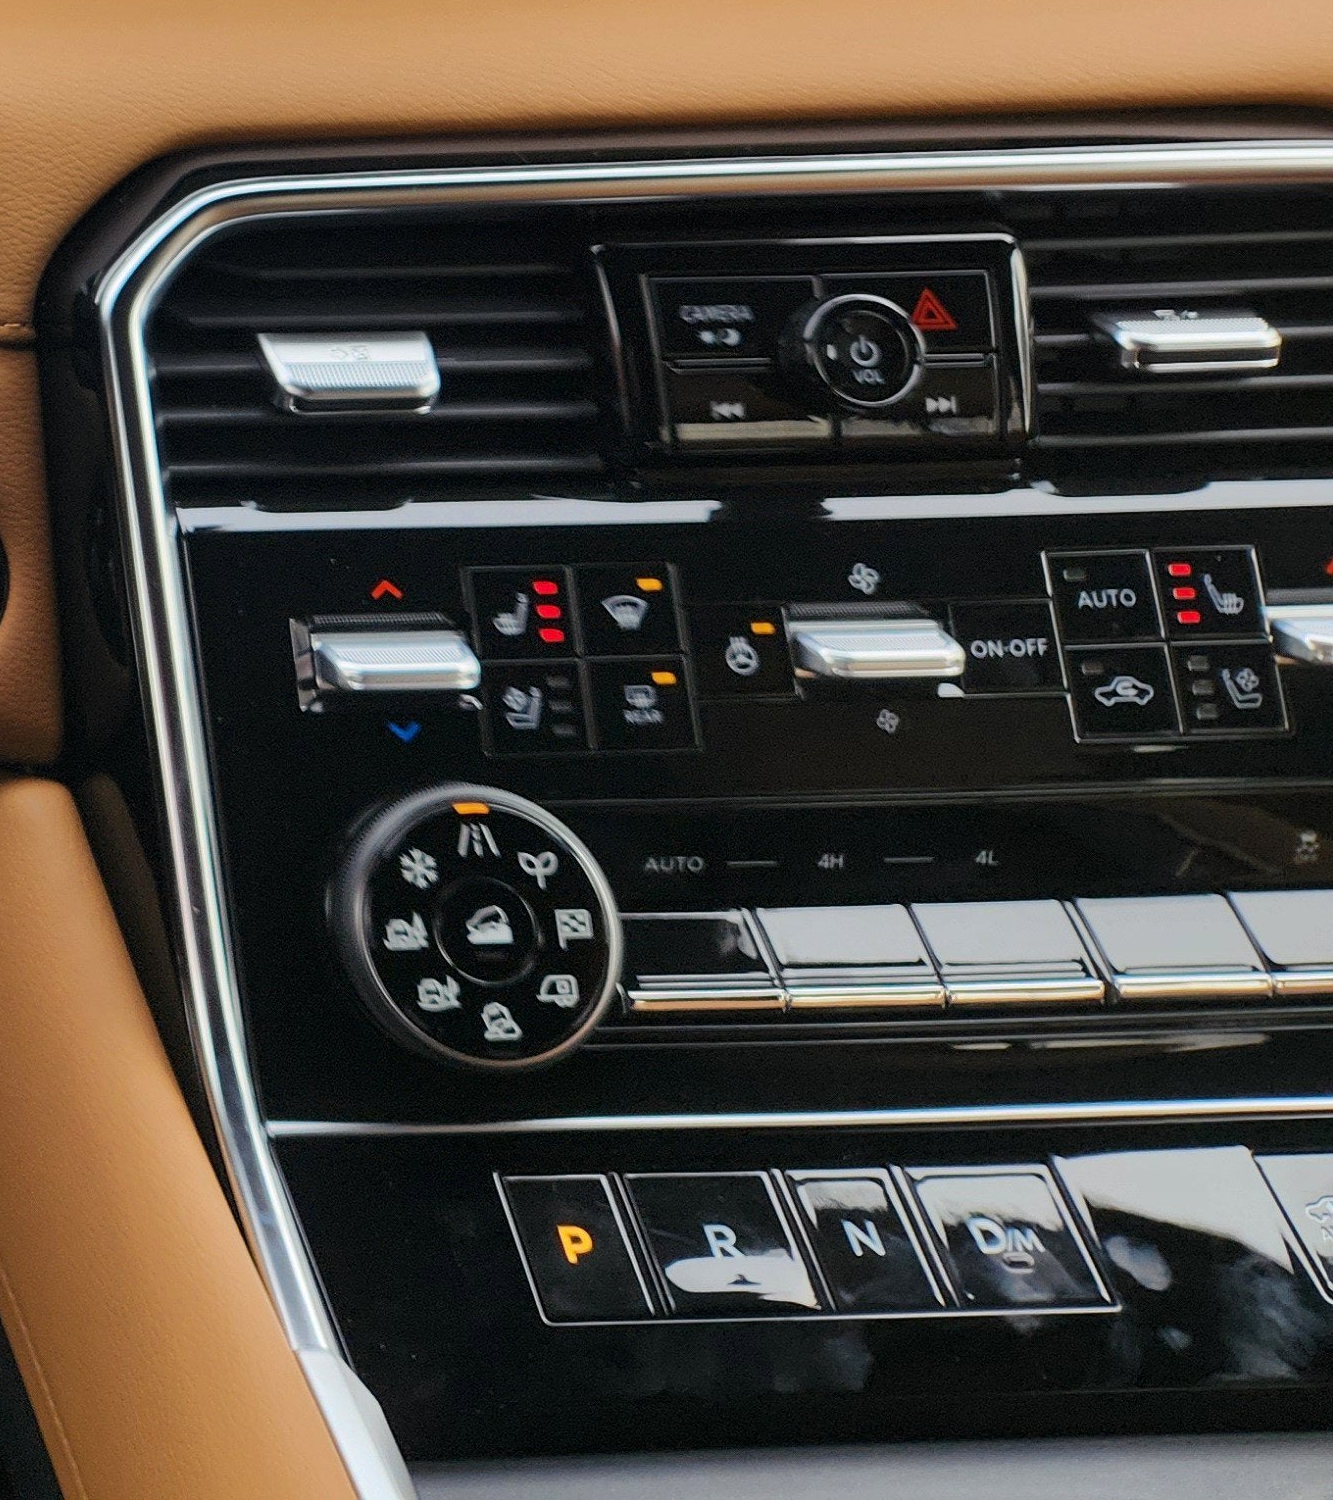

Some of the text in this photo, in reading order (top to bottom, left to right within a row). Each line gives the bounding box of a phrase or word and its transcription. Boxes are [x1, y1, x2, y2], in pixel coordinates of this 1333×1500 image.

[852, 368, 885, 386] VOL
[1078, 588, 1137, 610] AUTO
[644, 856, 705, 873] AUTO
[817, 851, 845, 870] 4H
[975, 849, 1000, 867] 4L
[555, 1224, 594, 1265] P
[702, 1223, 748, 1260] R
[841, 1219, 886, 1257] N
